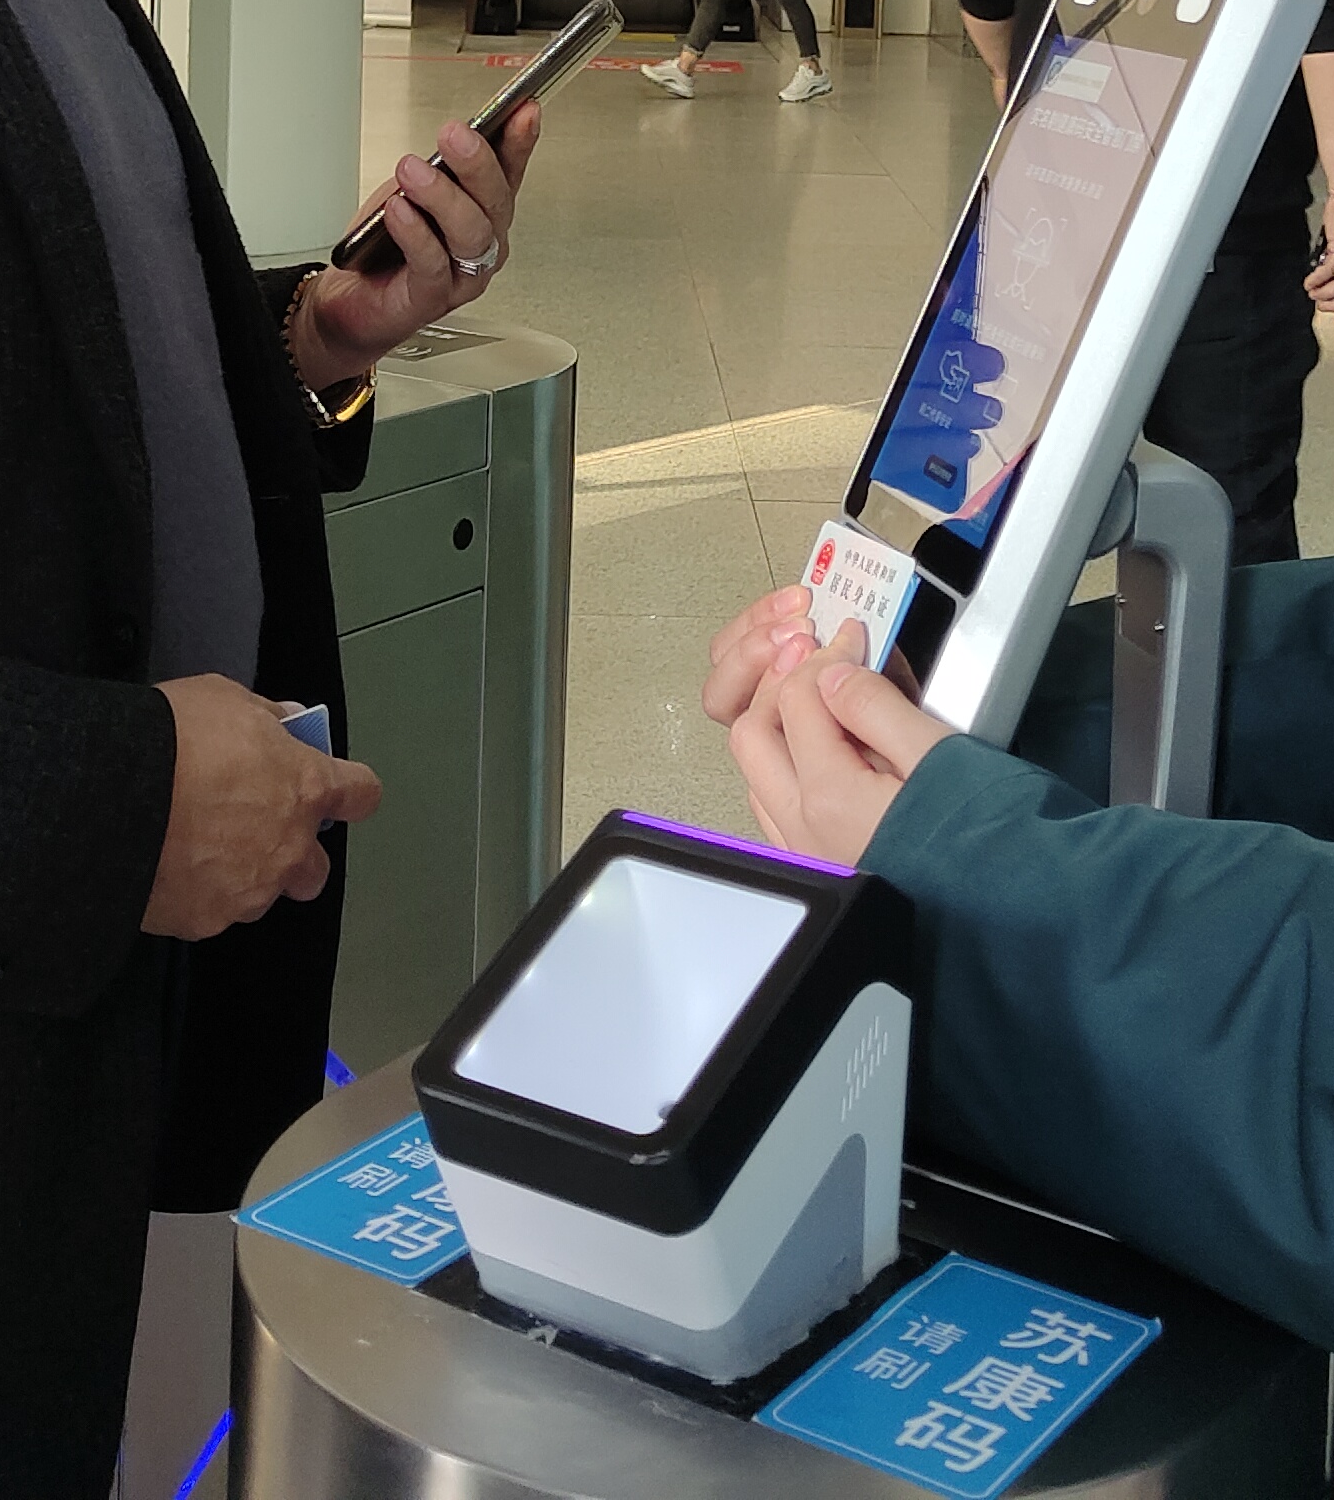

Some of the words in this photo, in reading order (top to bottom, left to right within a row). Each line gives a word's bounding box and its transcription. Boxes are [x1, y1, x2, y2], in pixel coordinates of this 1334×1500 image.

[829, 572, 891, 619] 居民身份证
[853, 1315, 968, 1390] 请刷
[895, 1307, 1114, 1474] 苏康码
